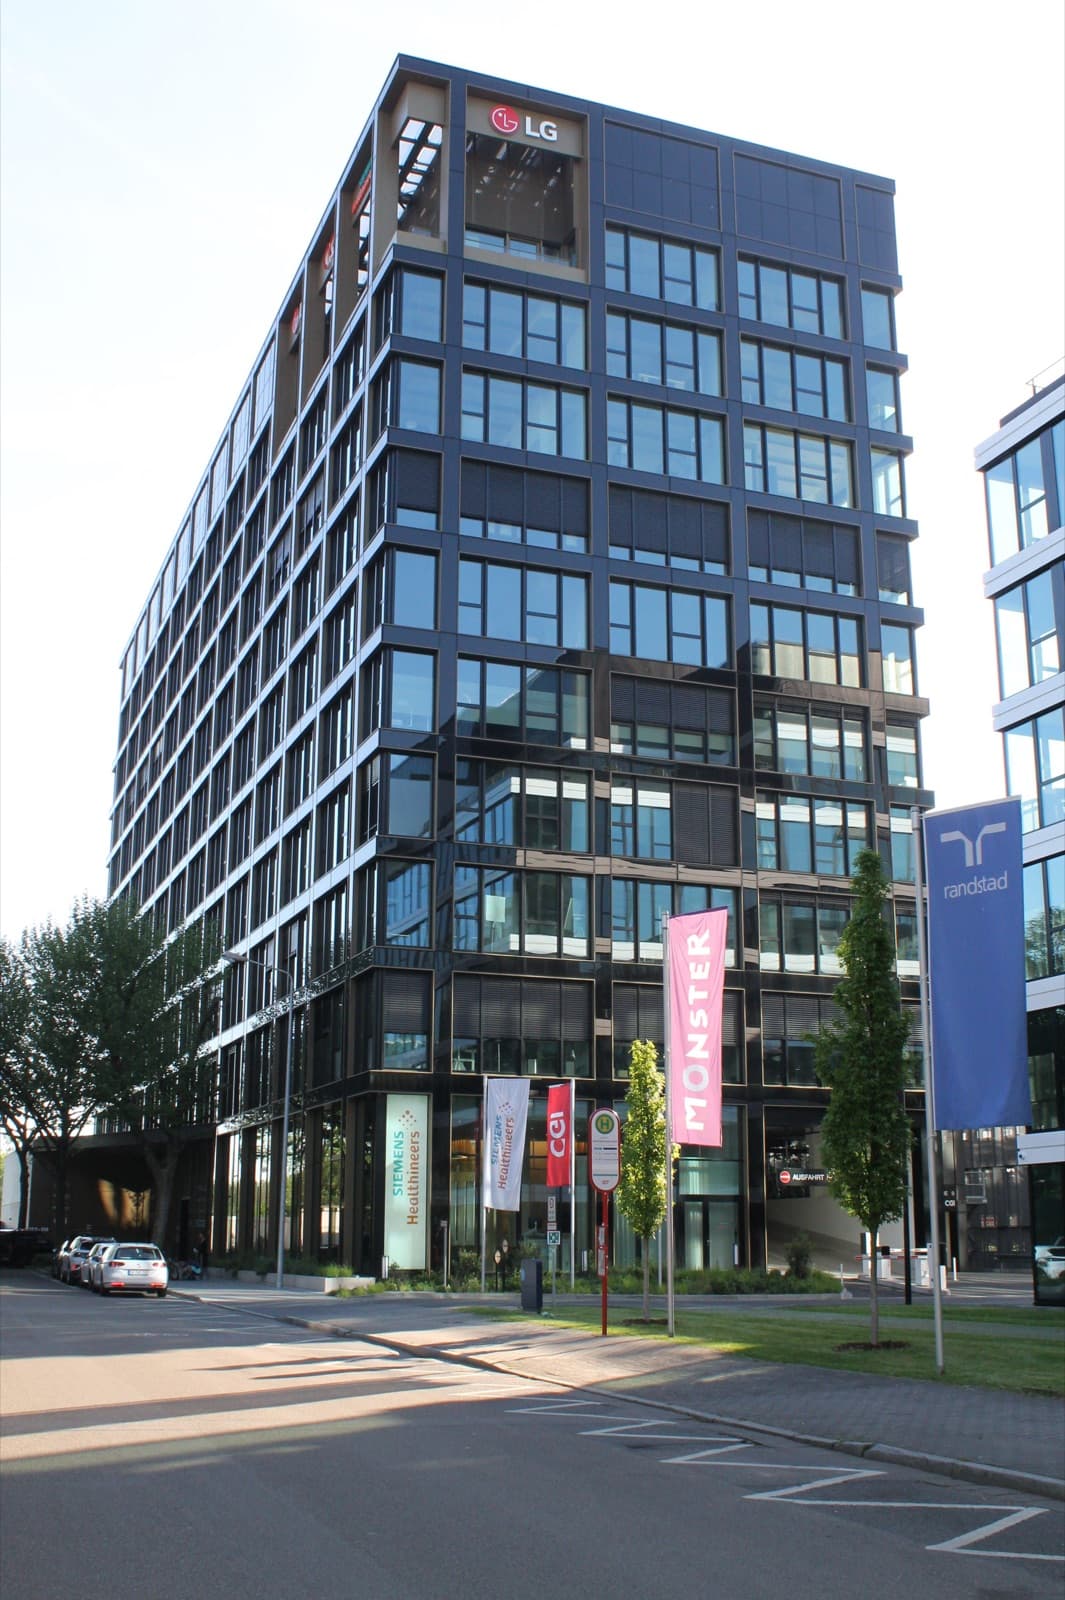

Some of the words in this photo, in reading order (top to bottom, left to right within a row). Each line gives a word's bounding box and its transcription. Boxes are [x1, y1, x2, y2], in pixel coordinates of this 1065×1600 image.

[525, 115, 558, 141] LG
[943, 870, 1008, 899] randstad
[682, 928, 710, 1130] MONSTER
[393, 1130, 405, 1197] SIEMENS
[491, 1114, 504, 1165] SIEMENS
[498, 1116, 515, 1190] Healthineers
[550, 1111, 567, 1158] CGI
[406, 1130, 421, 1225] Healthineers
